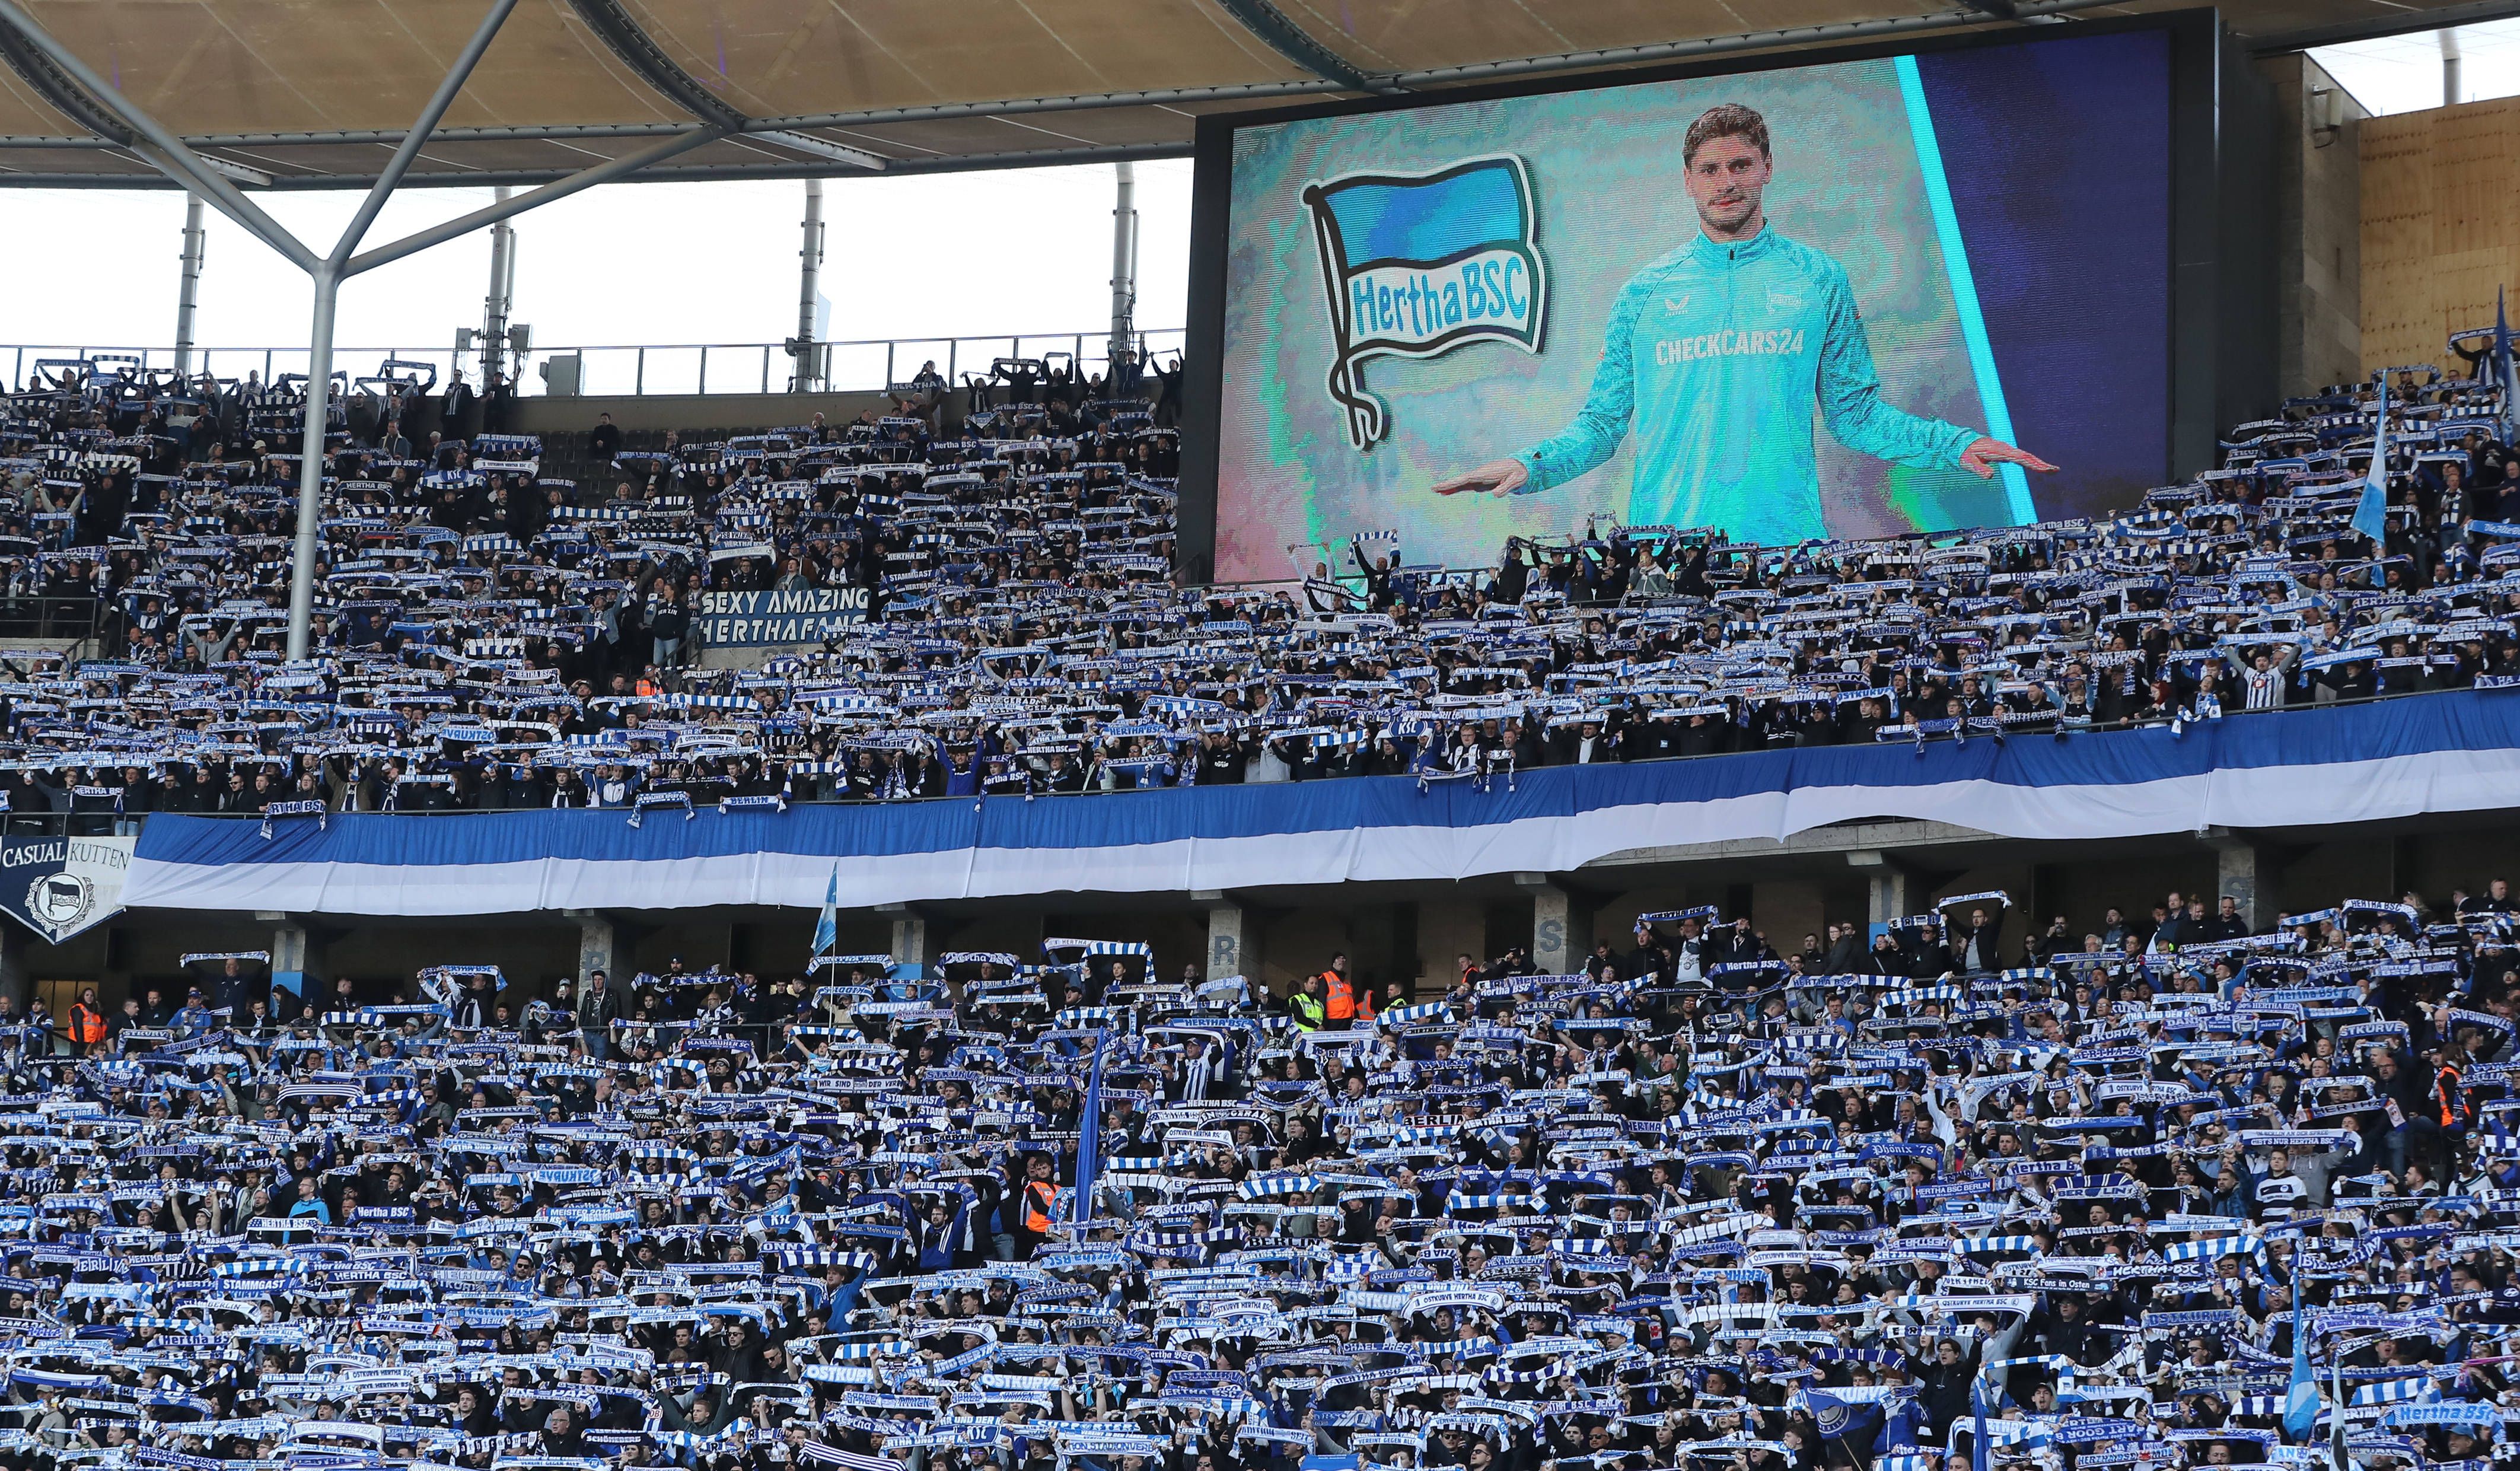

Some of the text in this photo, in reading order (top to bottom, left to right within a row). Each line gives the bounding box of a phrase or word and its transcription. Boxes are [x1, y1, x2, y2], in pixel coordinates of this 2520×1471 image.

[1352, 258, 1528, 339] Hertha BSC
[1656, 329, 1804, 364] CHECKCARS24
[702, 587, 869, 615] SEXY AMAZING
[699, 614, 866, 643] HERTHAFAN
[2, 842, 129, 870] CASUAL KUTTEN
[1538, 919, 1562, 952] S
[1214, 935, 1235, 964] R
[1726, 960, 1779, 970] Hertha BSC
[2260, 957, 2310, 968] BERLIN
[1512, 984, 1530, 993] BSC
[2451, 1011, 2510, 1033] STAMMGAST
[1025, 1076, 1066, 1085] BERLIN
[1707, 1106, 1766, 1122] Hertha BSC
[1406, 1115, 1464, 1126] BERLIN
[1873, 1145, 1933, 1156] Phönix '78
[1916, 1182, 1990, 1196] HERTHA BSC BERLIN
[358, 1206, 409, 1217] Hertha BSC
[2374, 1199, 2419, 1212] ARSTEINER
[1250, 1237, 1321, 1247] BERLIN
[334, 1271, 380, 1280] HERTHA
[224, 1279, 285, 1289] STAMMGAST
[2024, 1278, 2038, 1287] KSC
[2041, 1278, 2056, 1287] Fans
[2069, 1280, 2090, 1288] Osten
[1967, 1418, 2017, 1432] HRTHA
[2067, 1428, 2105, 1438] GOOR
